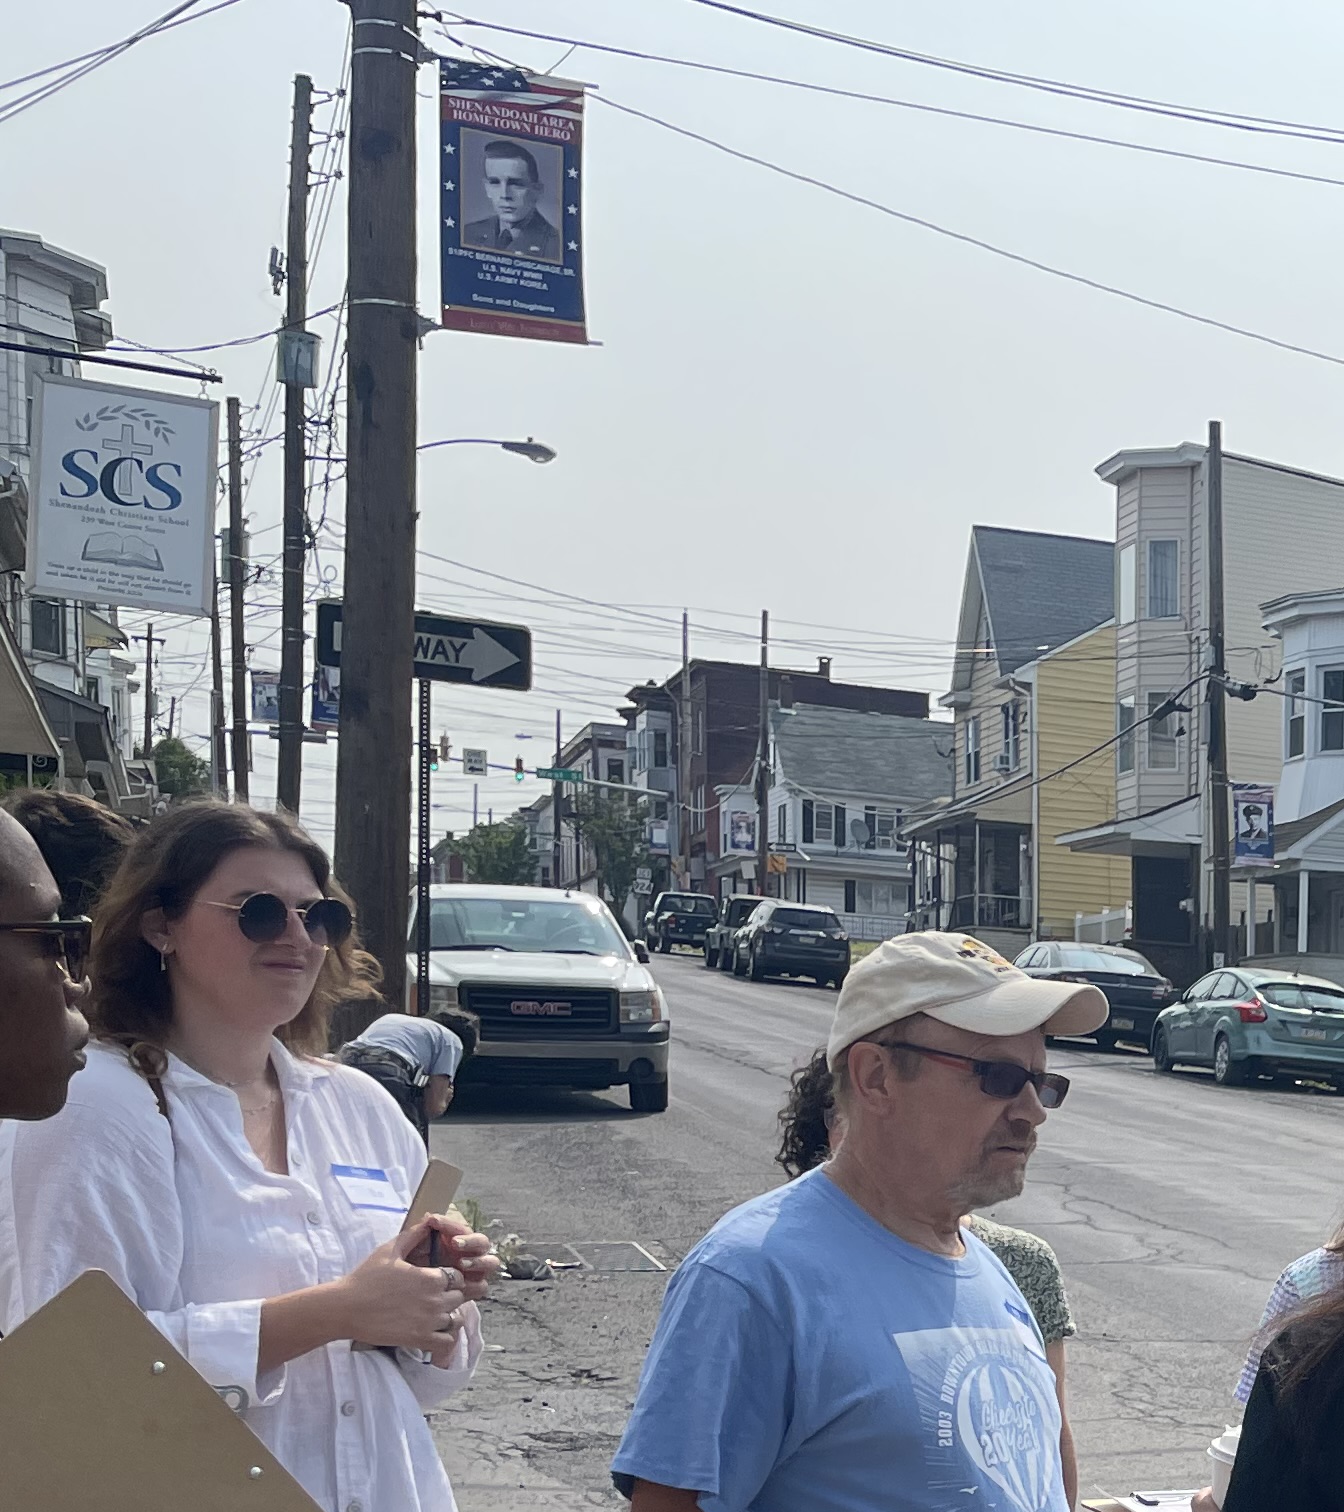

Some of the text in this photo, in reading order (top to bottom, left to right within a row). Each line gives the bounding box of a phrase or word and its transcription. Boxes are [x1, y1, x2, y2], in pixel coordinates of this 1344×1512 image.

[448, 98, 575, 131] SHENANDOAH AREA
[452, 109, 571, 141] HOMETOWN HERO
[477, 272, 549, 291] U.S. ARMY KOREA
[482, 263, 498, 272] U.S.
[499, 266, 521, 276] NAVY
[495, 298, 512, 306] and
[59, 449, 183, 511] SCS
[48, 498, 190, 527] Shenandoah Christian School
[414, 636, 467, 664] WAY
[511, 1001, 572, 1016] GMC
[938, 1410, 954, 1447] 2003
[980, 1431, 1010, 1469] 20
